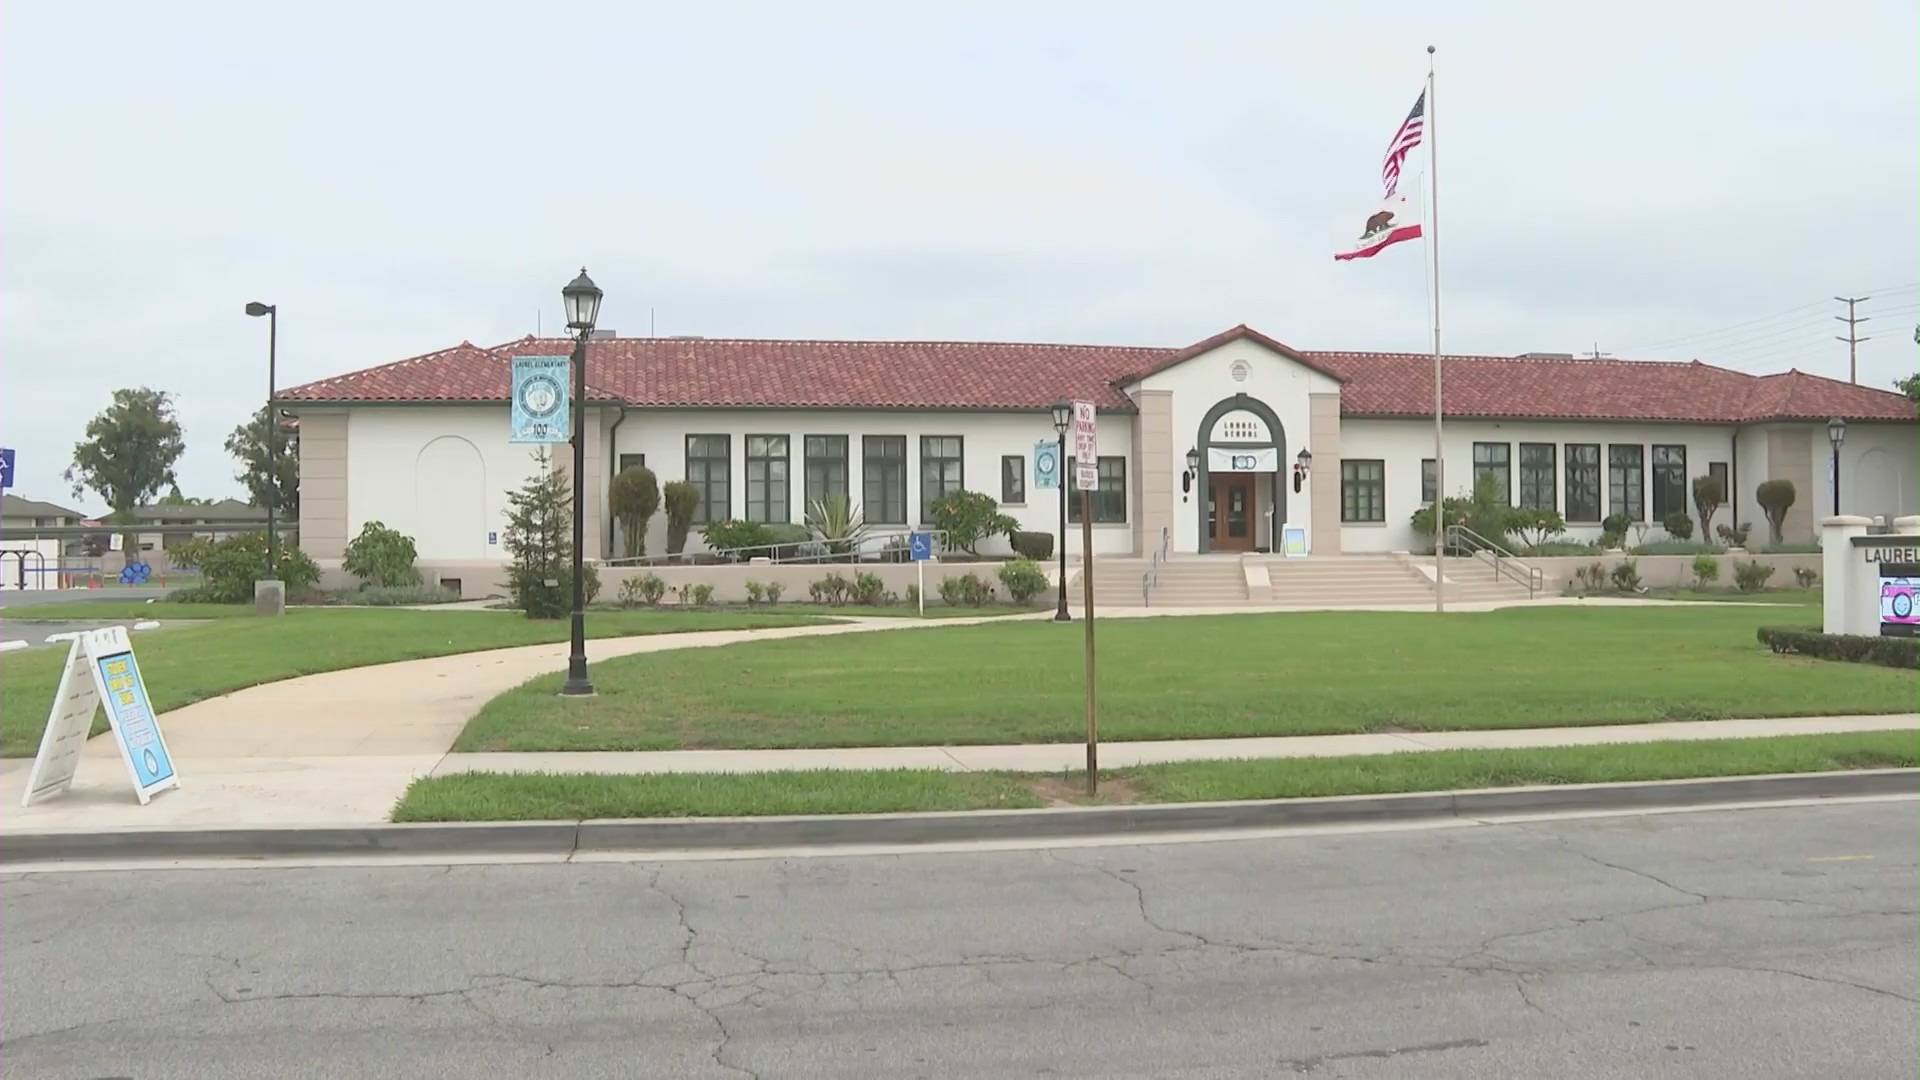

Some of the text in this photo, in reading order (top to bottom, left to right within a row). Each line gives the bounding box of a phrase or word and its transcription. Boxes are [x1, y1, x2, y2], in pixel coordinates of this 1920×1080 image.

[1080, 407, 1090, 420] NO
[533, 423, 548, 436] 100
[1076, 421, 1096, 433] PARKING
[1865, 548, 1920, 563] LAUREL
